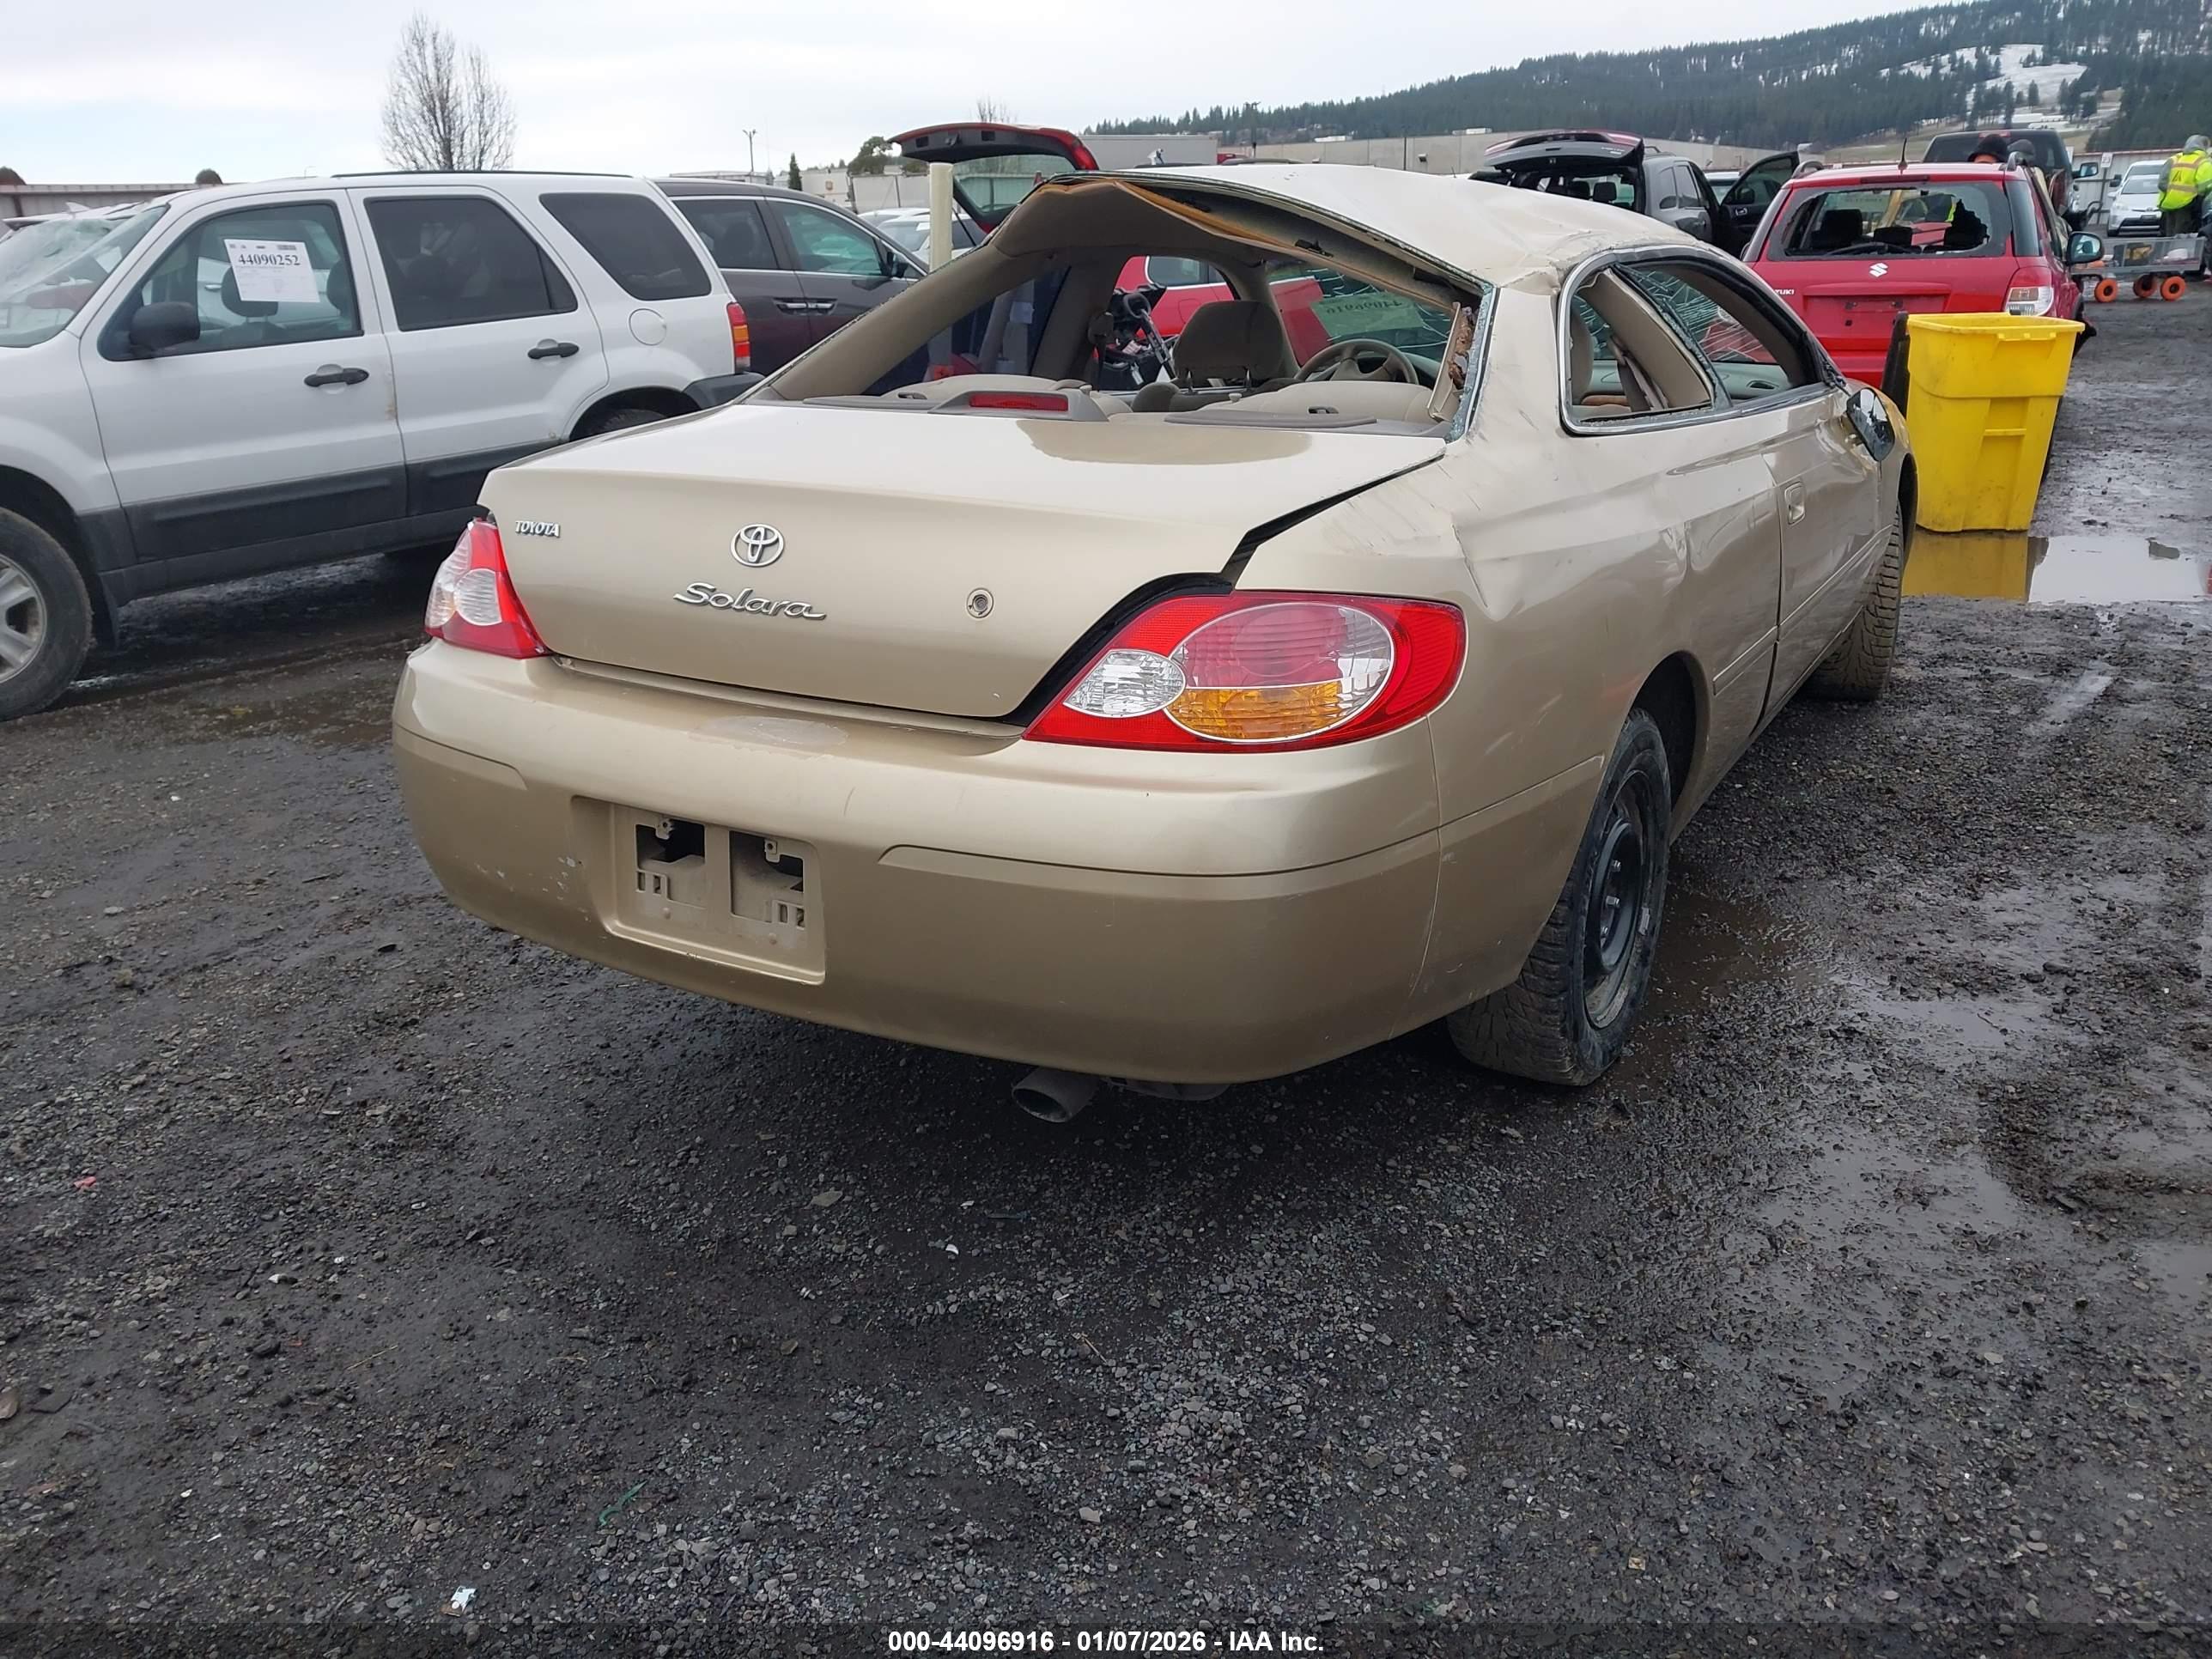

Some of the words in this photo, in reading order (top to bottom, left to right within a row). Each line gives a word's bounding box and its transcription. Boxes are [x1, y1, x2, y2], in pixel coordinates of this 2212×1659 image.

[239, 253, 301, 265] 44090252
[514, 520, 561, 538] TOYOTA
[673, 582, 827, 620] Solara
